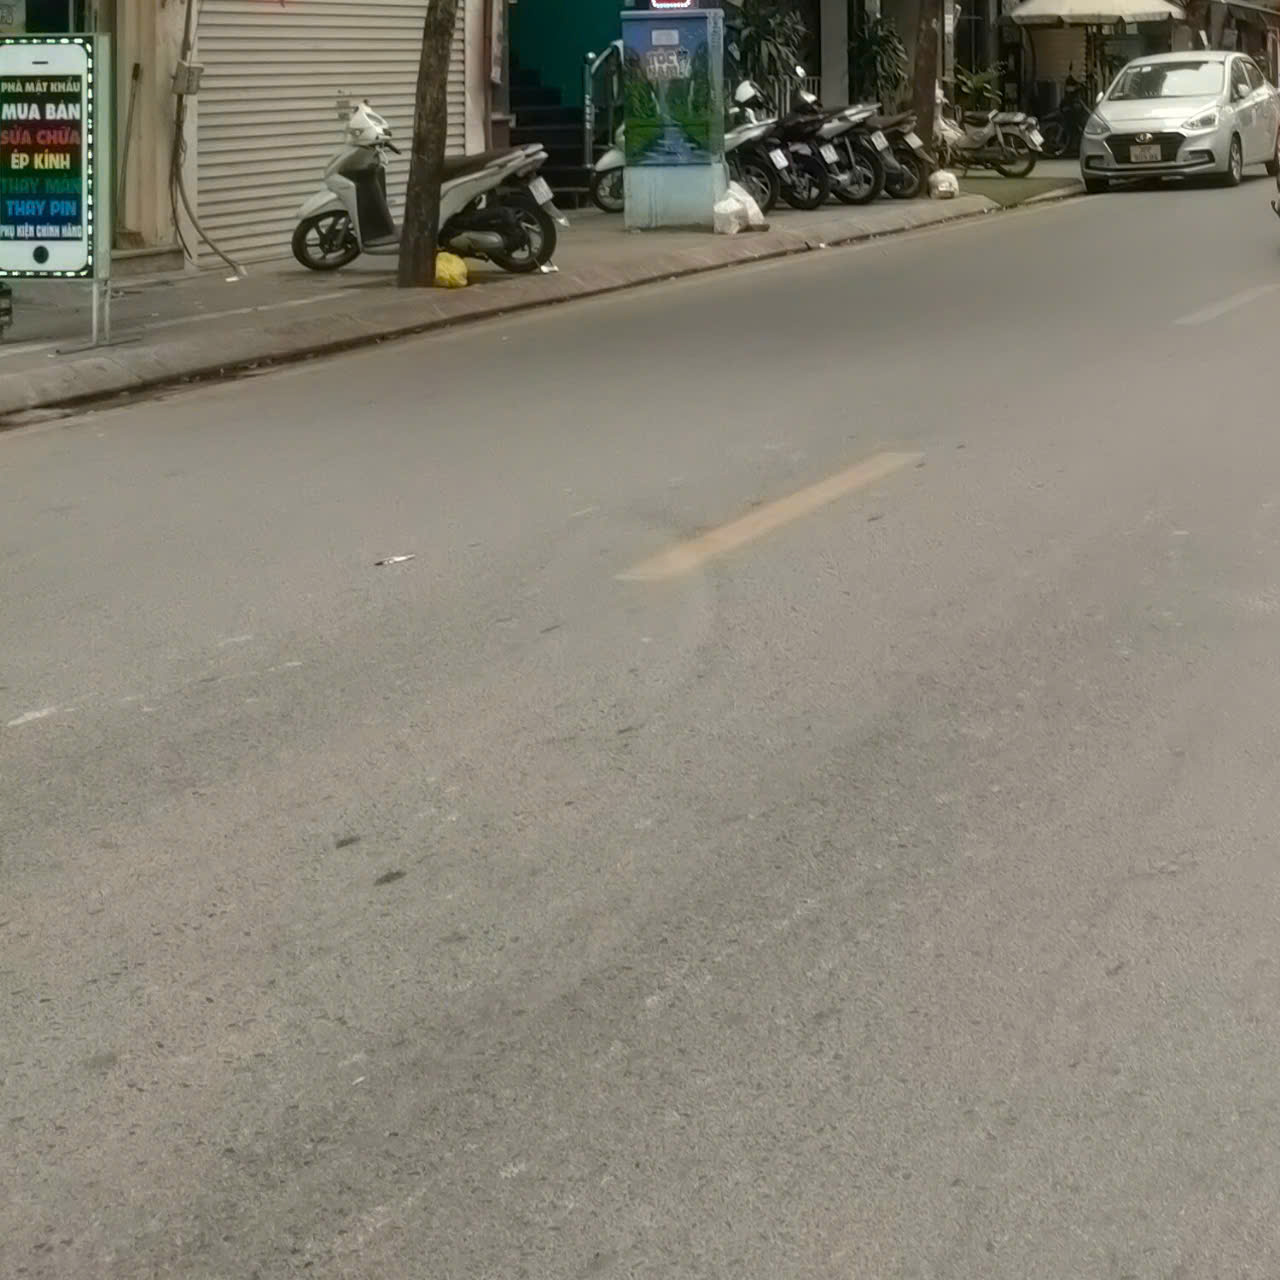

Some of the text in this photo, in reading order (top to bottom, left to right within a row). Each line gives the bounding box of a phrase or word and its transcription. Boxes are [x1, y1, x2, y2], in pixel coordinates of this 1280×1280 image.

[1, 100, 80, 120] MUA BÁN
[36, 126, 80, 144] CHỮA
[11, 148, 70, 169] ÉP KÍNH
[6, 200, 77, 216] THAY PIN
